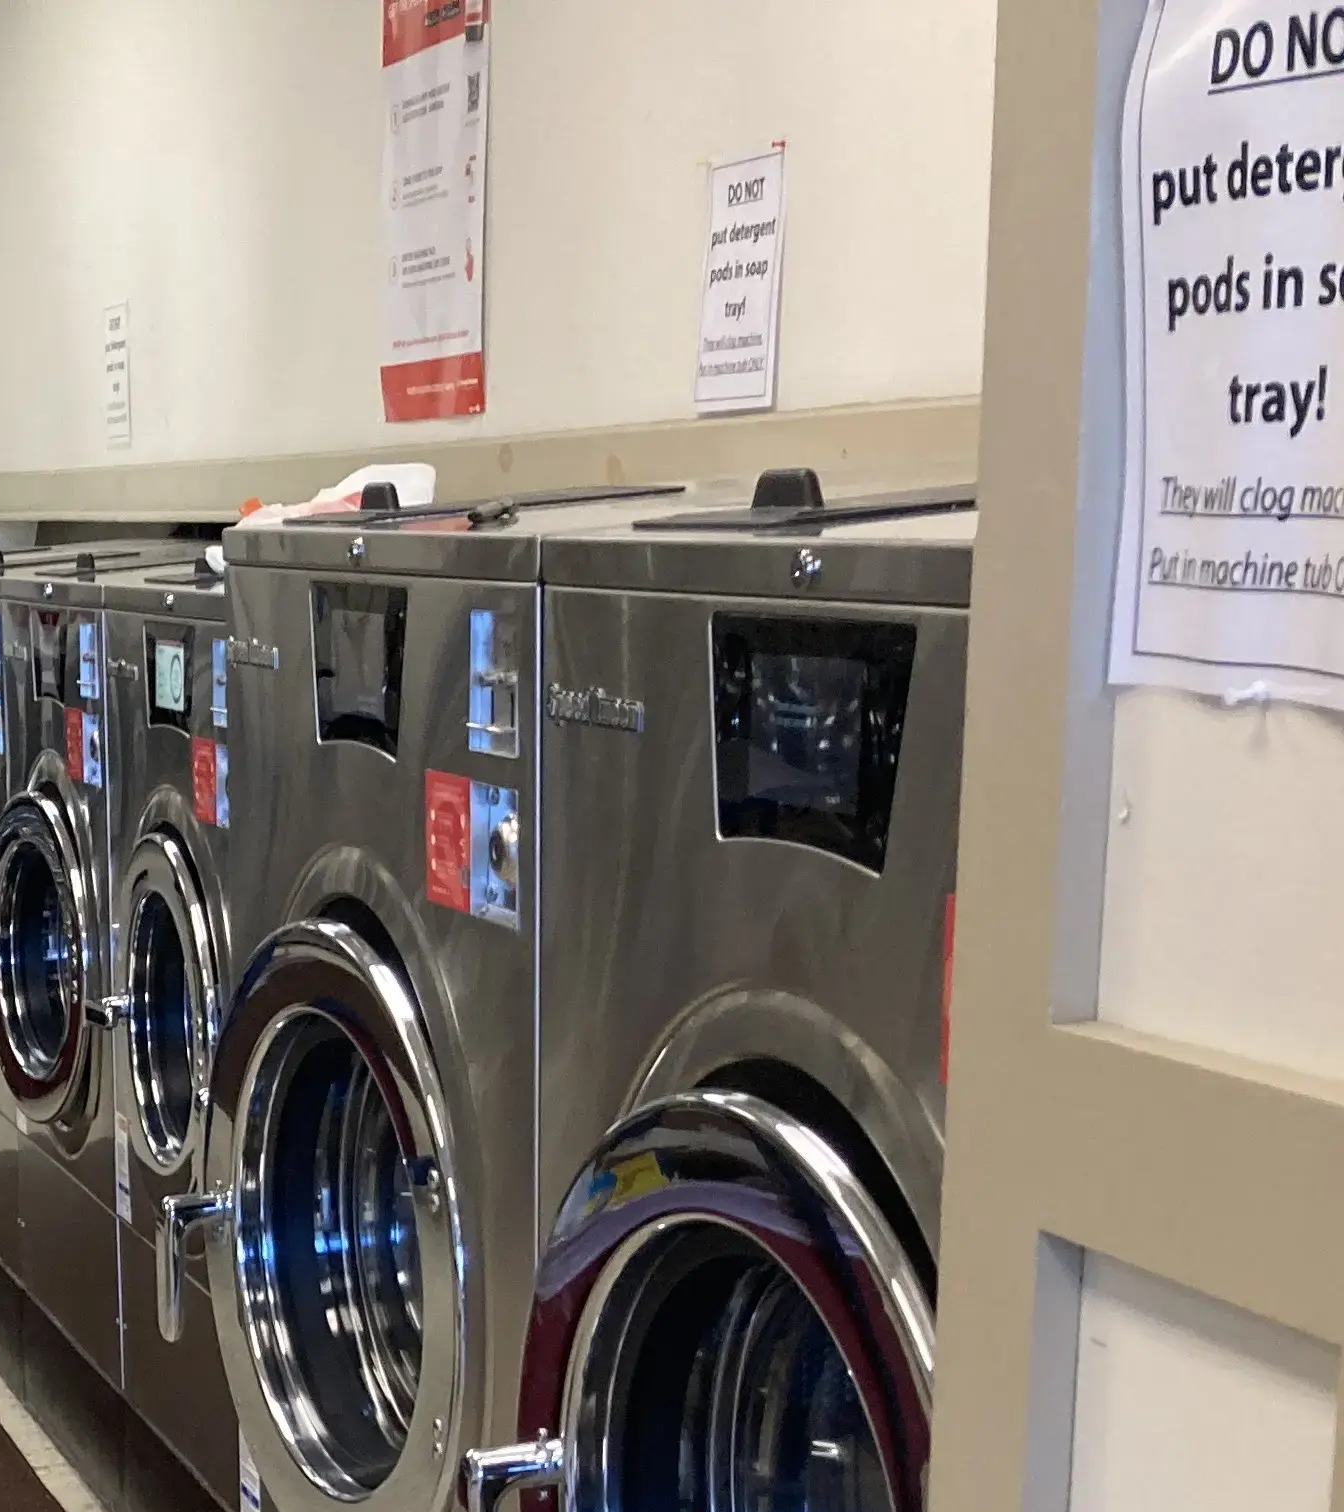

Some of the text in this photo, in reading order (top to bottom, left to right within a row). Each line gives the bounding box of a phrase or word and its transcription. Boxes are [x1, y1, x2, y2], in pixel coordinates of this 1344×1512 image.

[1211, 19, 1274, 84] DO
[728, 176, 765, 204] DO NOT
[1152, 140, 1344, 226] put deter
[711, 217, 776, 251] put detergent
[709, 259, 769, 288] pods in soap
[1168, 251, 1344, 332] pods in s
[1229, 364, 1328, 438] tray!
[1162, 475, 1201, 518] They
[1204, 475, 1237, 512] will
[1240, 475, 1296, 521] clog
[1149, 546, 1179, 580] Put
[1181, 549, 1197, 583] in
[1199, 549, 1298, 588] machine
[1303, 552, 1333, 590] tub
